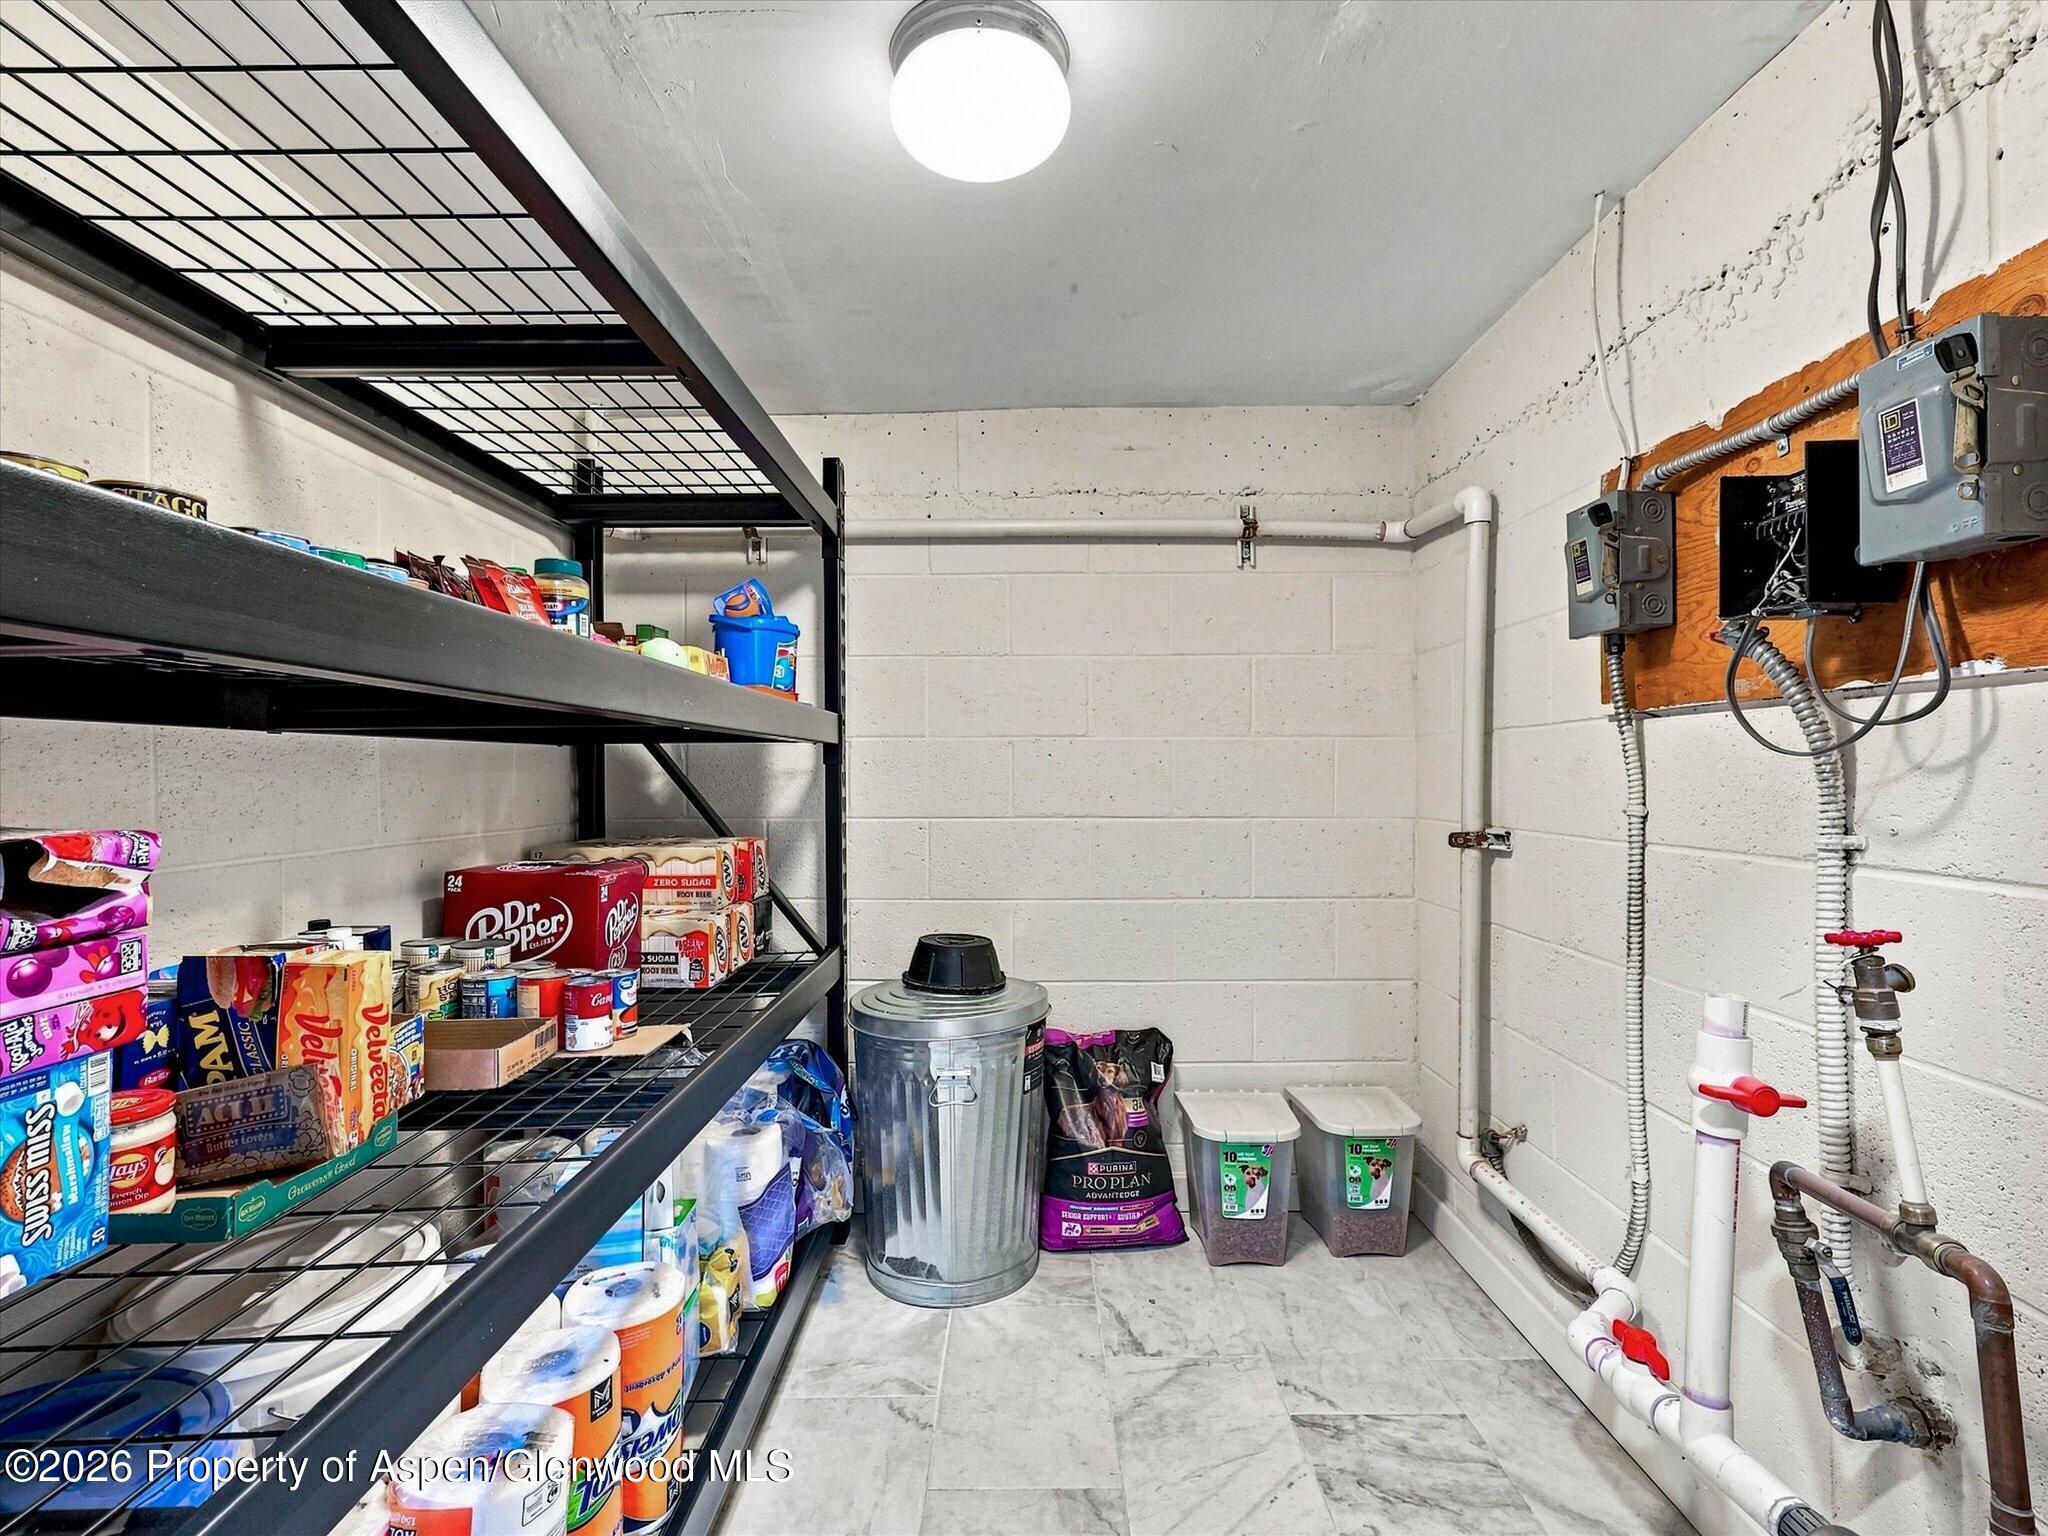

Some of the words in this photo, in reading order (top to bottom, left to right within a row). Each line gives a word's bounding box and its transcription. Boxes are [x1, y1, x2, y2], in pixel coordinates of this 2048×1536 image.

[447, 875, 463, 888] 24
[653, 878, 679, 887] ZERO
[680, 878, 712, 887] SUGAR
[504, 900, 541, 929] Dr
[647, 955, 676, 963] SUGAR
[349, 1047, 358, 1092] ORIGINAL
[361, 1003, 390, 1122] Velveeta
[200, 1100, 243, 1125] ACT
[206, 1138, 239, 1153] Butter
[240, 1131, 275, 1147] Lovers
[1099, 1164, 1135, 1173] PURINA
[1072, 1174, 1107, 1190] PRO
[1110, 1172, 1152, 1190] PLAN
[134, 1192, 150, 1205] Dip
[91, 1226, 106, 1247] 30
